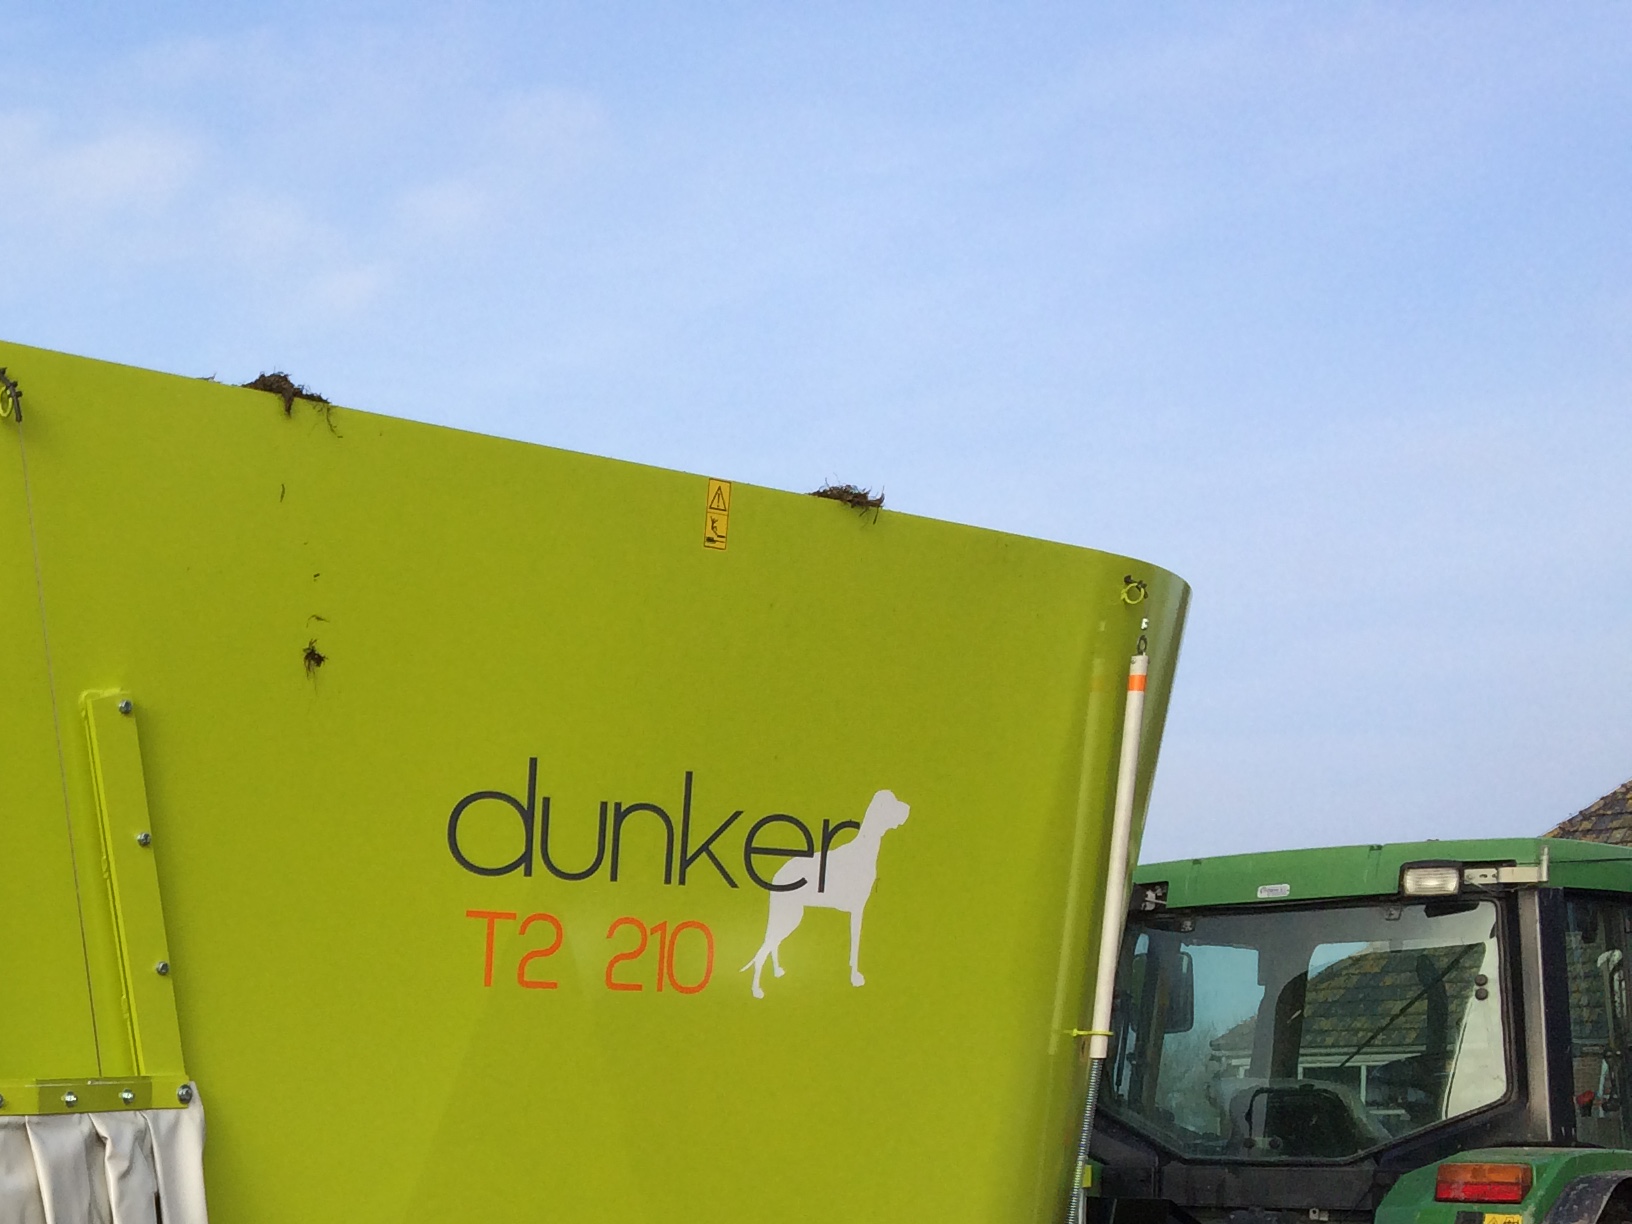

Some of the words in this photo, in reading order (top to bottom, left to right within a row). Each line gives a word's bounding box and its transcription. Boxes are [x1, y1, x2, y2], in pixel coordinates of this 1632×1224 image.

[447, 757, 860, 894] dunker
[465, 908, 564, 989] T2
[605, 915, 714, 994] 210
